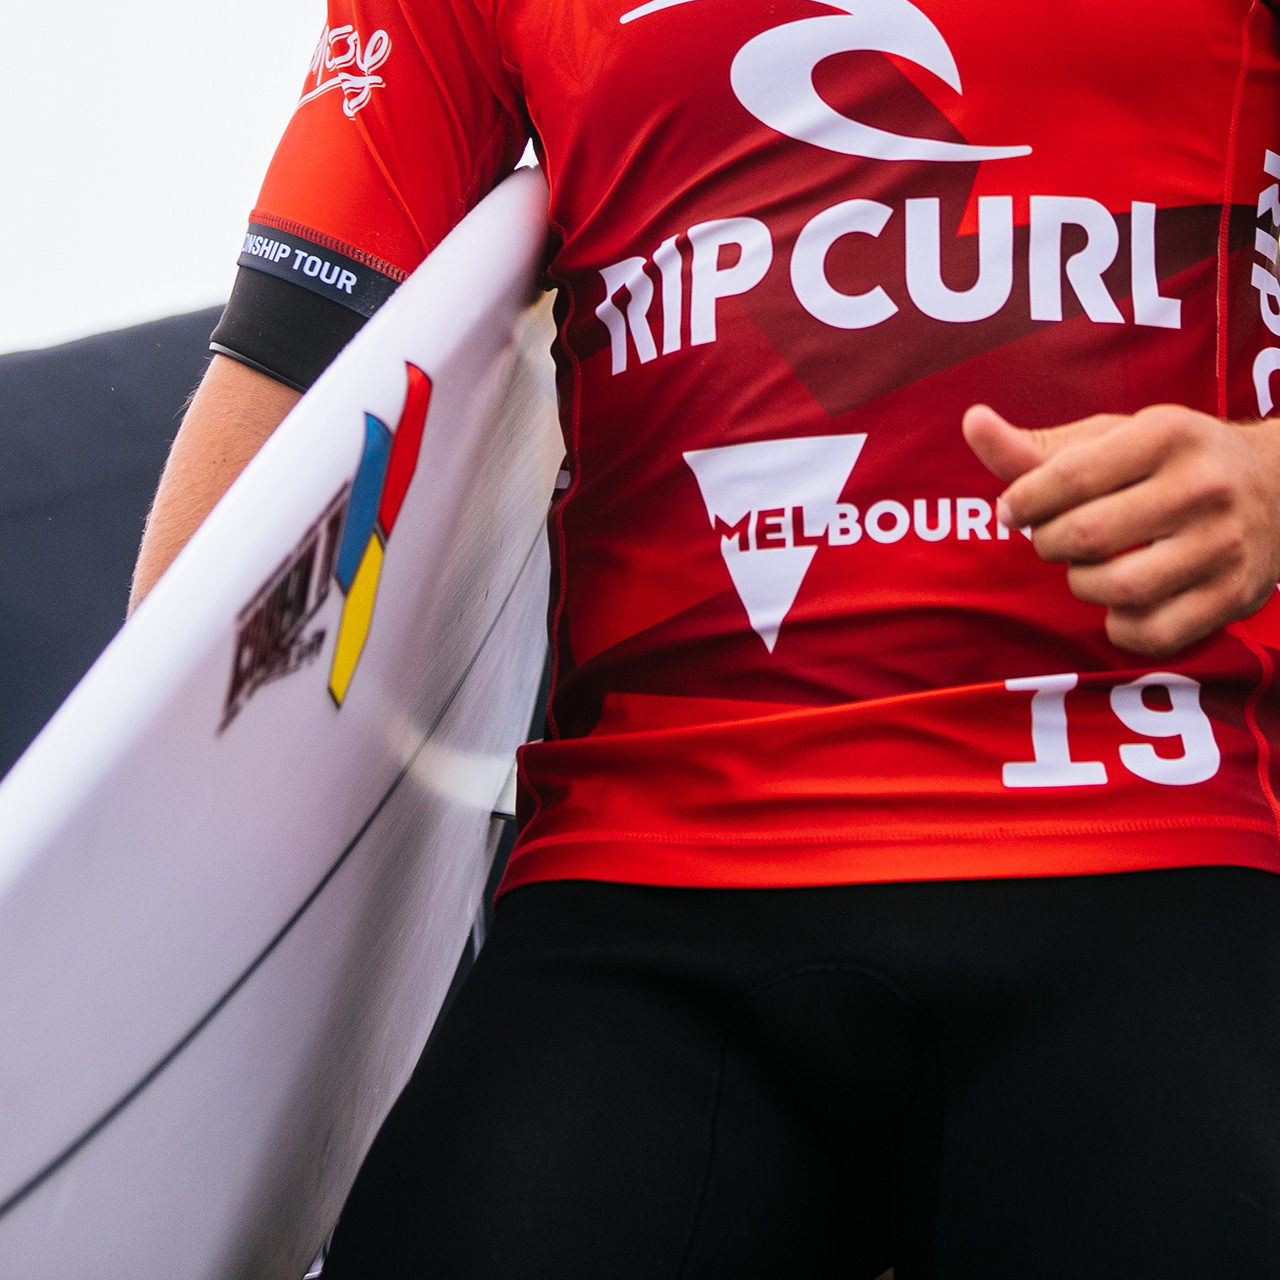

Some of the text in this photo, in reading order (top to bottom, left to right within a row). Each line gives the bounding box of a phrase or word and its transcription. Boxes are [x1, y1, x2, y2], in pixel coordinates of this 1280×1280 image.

[292, 248, 357, 295] TOUR
[595, 195, 1182, 377] RIP CURL
[1001, 672, 1221, 788] 19
